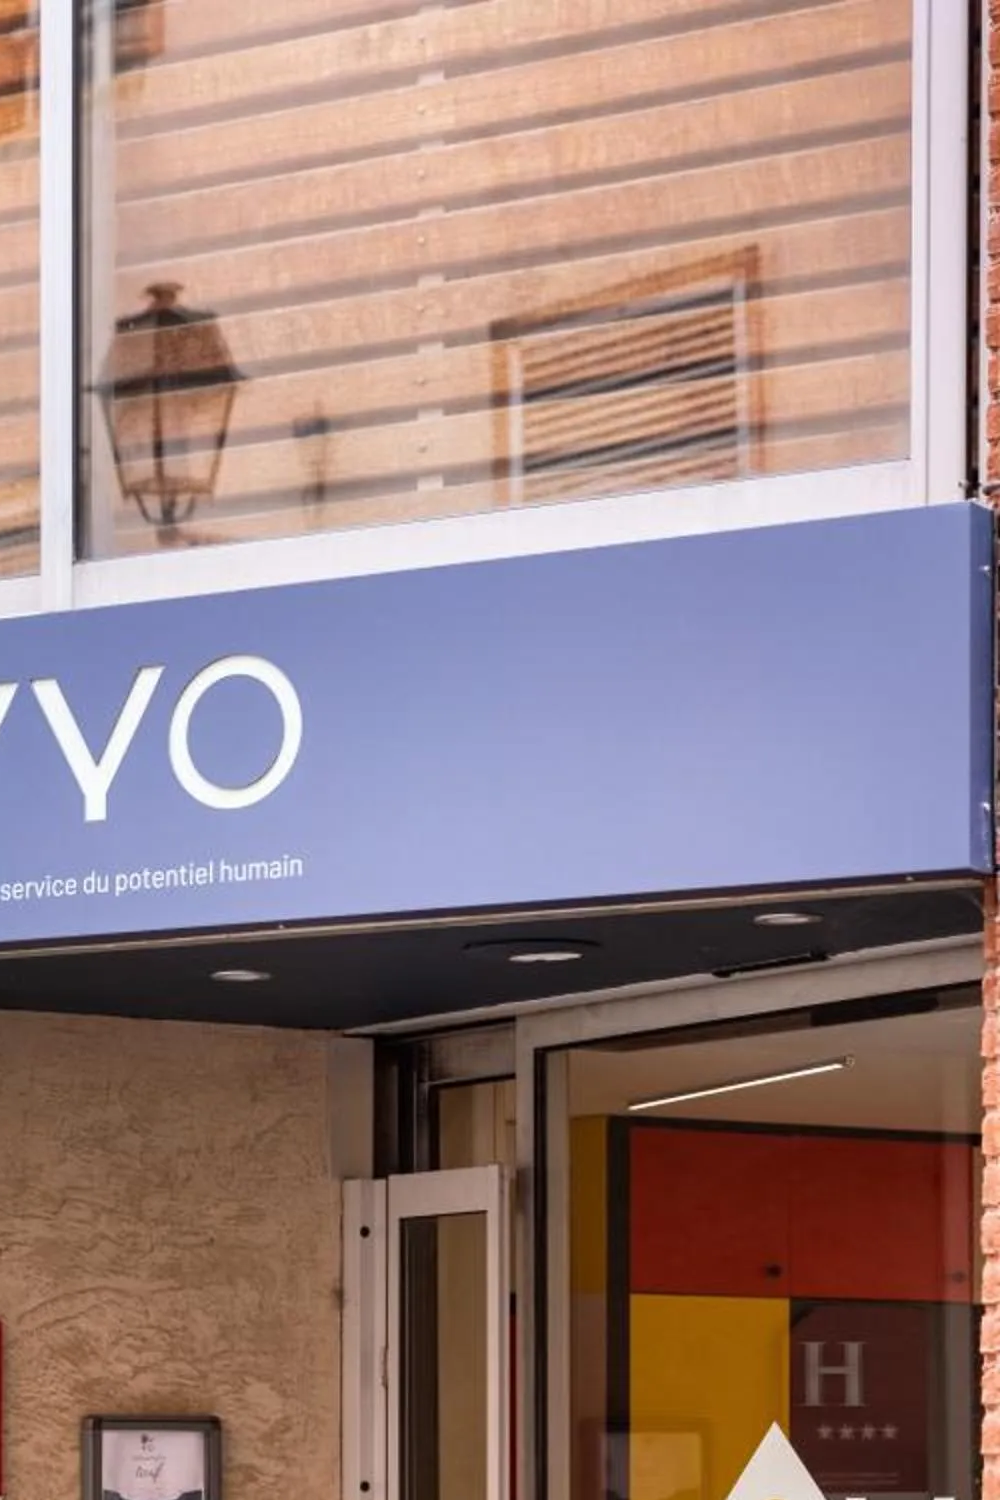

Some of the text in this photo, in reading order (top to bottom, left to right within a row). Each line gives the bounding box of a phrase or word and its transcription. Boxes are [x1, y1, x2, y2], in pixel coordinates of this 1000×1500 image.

[0, 875, 77, 901] service
[83, 870, 109, 894] du
[115, 860, 214, 897] potentiel
[219, 855, 303, 883] humain
